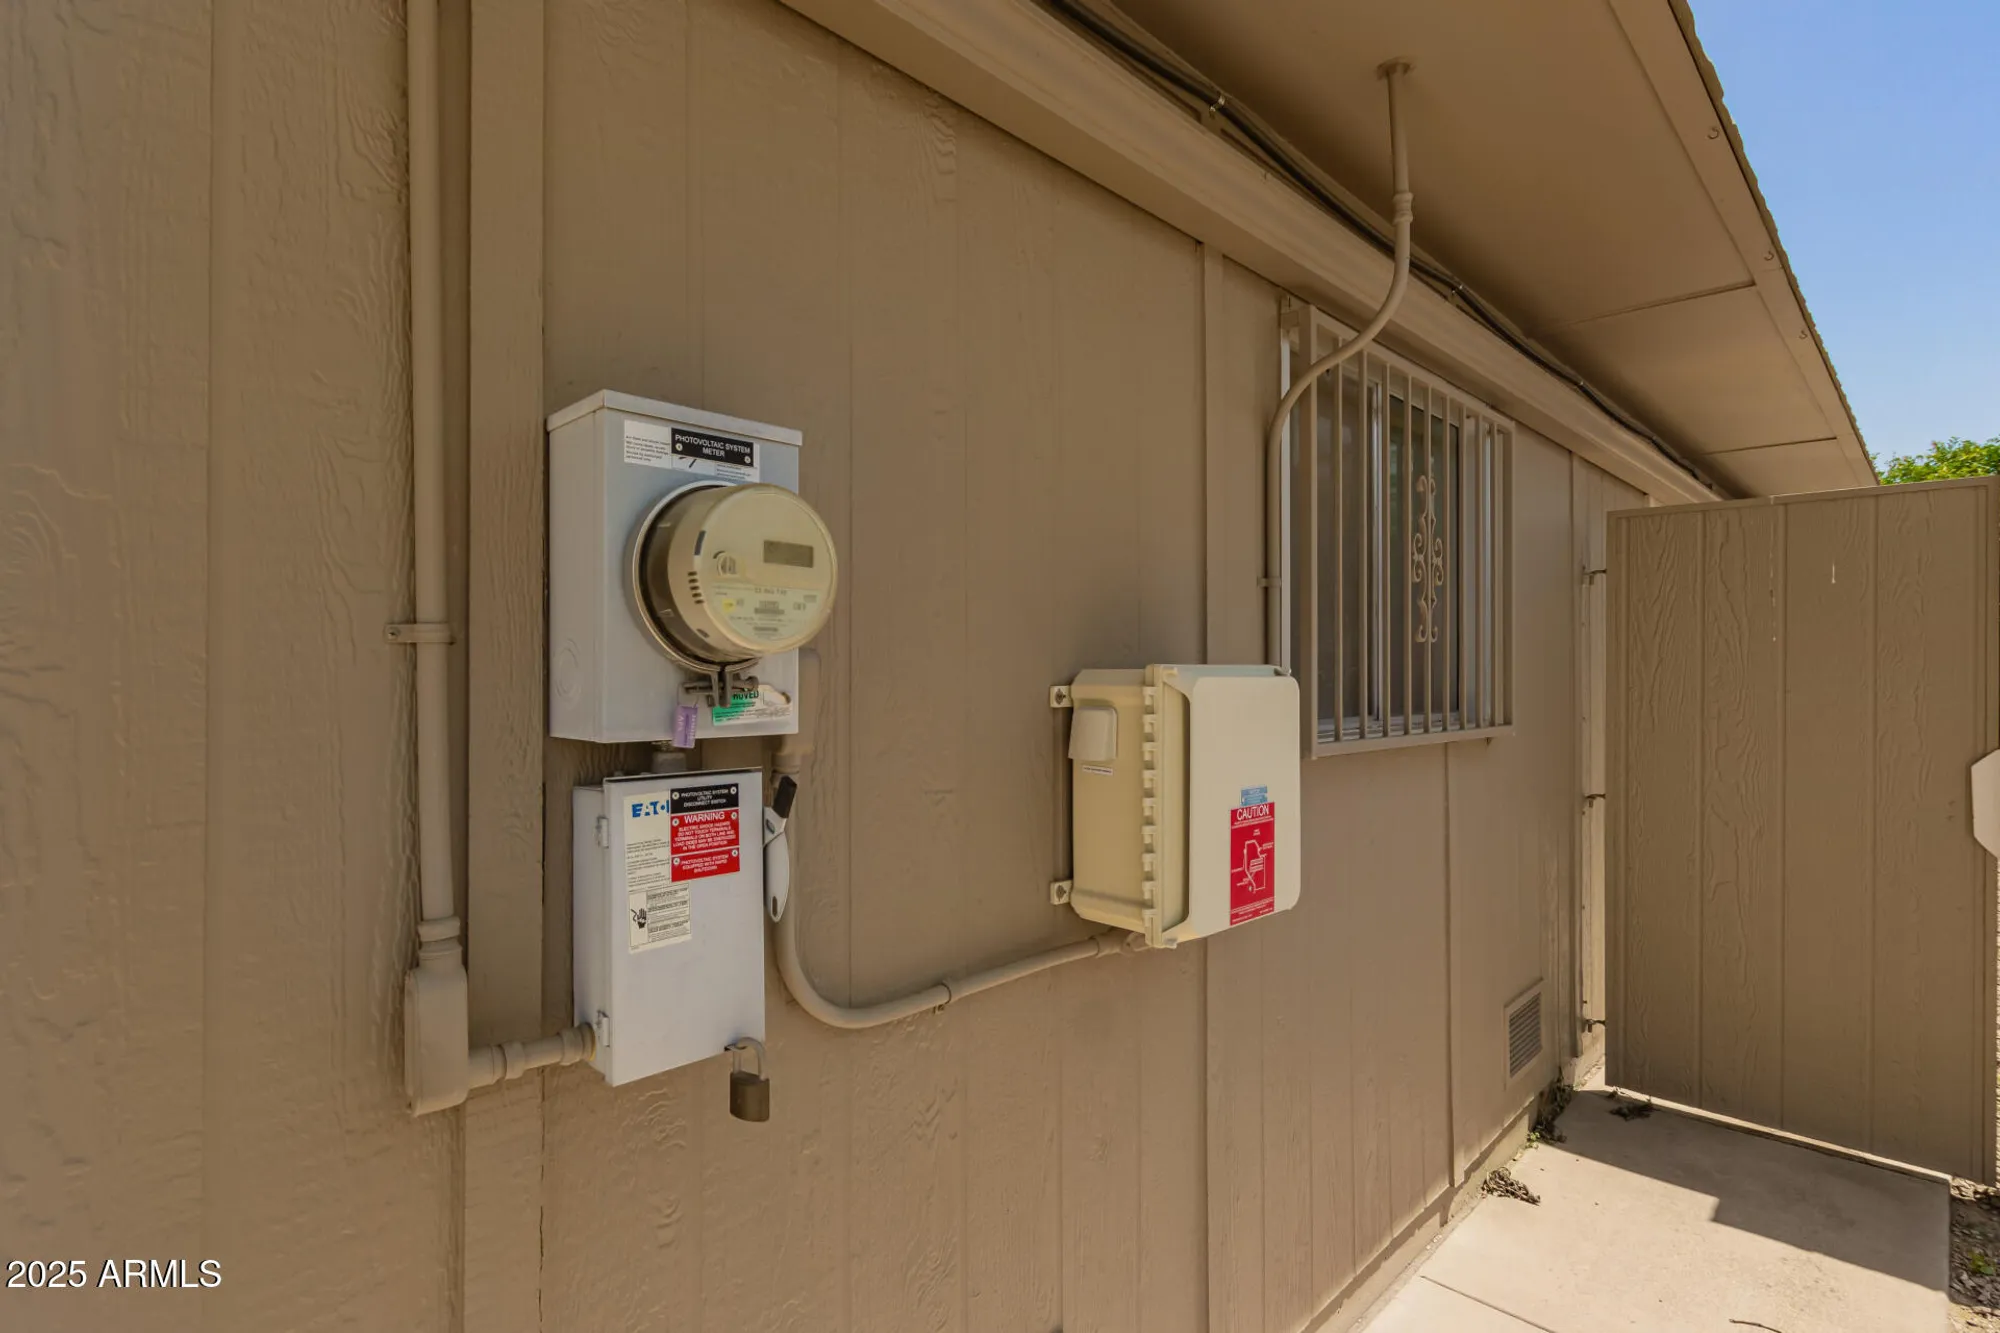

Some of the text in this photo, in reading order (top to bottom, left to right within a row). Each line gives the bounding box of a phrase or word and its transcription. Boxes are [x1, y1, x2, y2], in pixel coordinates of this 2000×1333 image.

[674, 434, 724, 449] PHOTOVOLTAIC
[725, 443, 751, 454] SYSTEM
[702, 447, 725, 457] METER
[684, 812, 725, 823] WARNING
[1236, 804, 1269, 821] CAUTION
